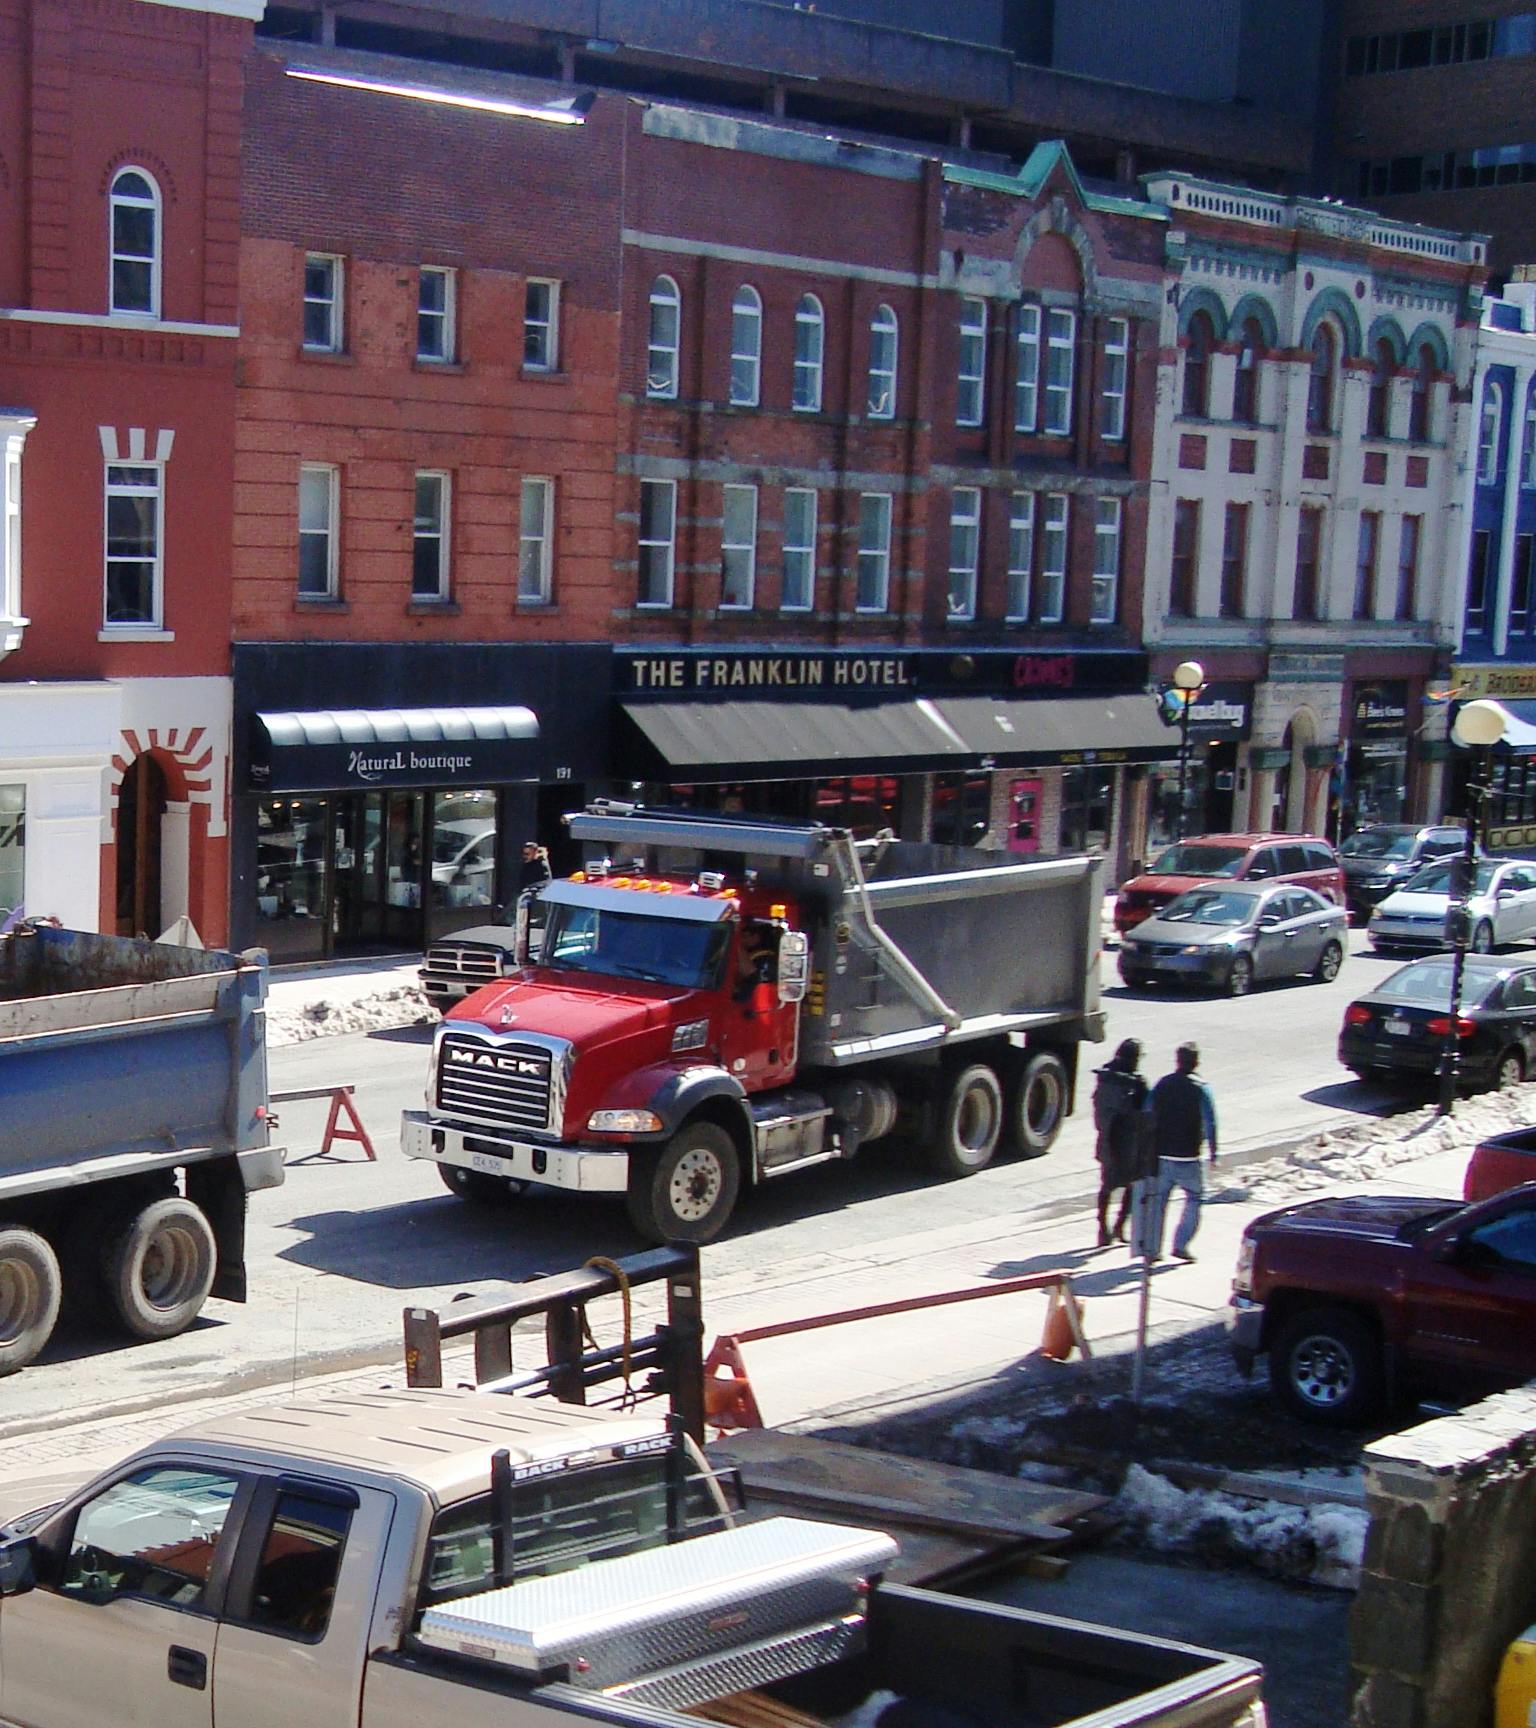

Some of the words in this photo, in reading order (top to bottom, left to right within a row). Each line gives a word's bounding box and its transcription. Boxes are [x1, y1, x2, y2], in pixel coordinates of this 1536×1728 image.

[632, 660, 685, 687] THE
[695, 660, 823, 687] FRANKLIN
[833, 660, 908, 685] HOTEL
[410, 751, 472, 773] boutique
[451, 1049, 541, 1075] MACK
[514, 1458, 566, 1480] BACK
[624, 1436, 673, 1456] RACK
